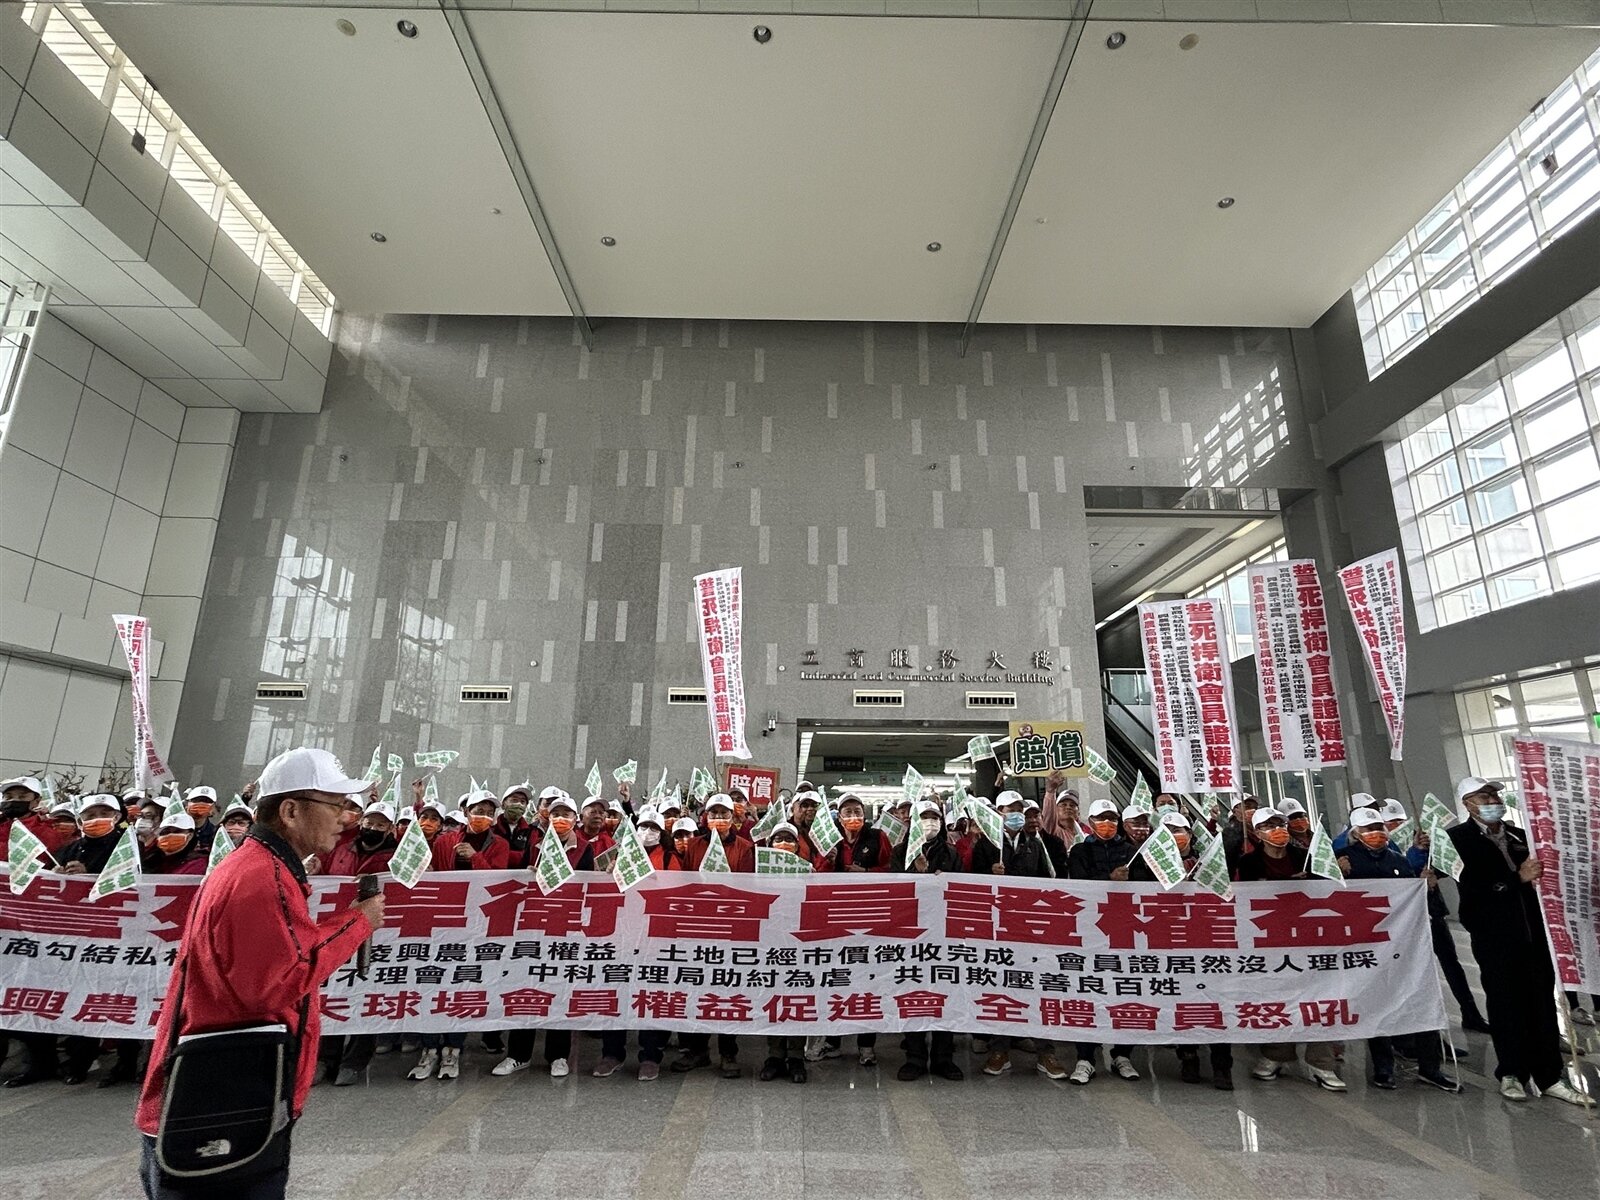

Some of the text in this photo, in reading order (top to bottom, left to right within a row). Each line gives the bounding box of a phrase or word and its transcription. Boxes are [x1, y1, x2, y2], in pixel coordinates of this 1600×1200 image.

[861, 671, 883, 681] and
[959, 673, 1002, 683] Service
[1005, 673, 1055, 686] Building
[1292, 563, 1347, 763] 誓死捍衛會員證權益
[1185, 601, 1233, 788] 誓死捍衛會員證權益
[1015, 731, 1084, 774] 賠償
[320, 964, 1206, 997] 不理會員，中科管理局助紂為虐，共同欺壓善良百姓。
[974, 993, 1360, 1031] 全體會員怒吼
